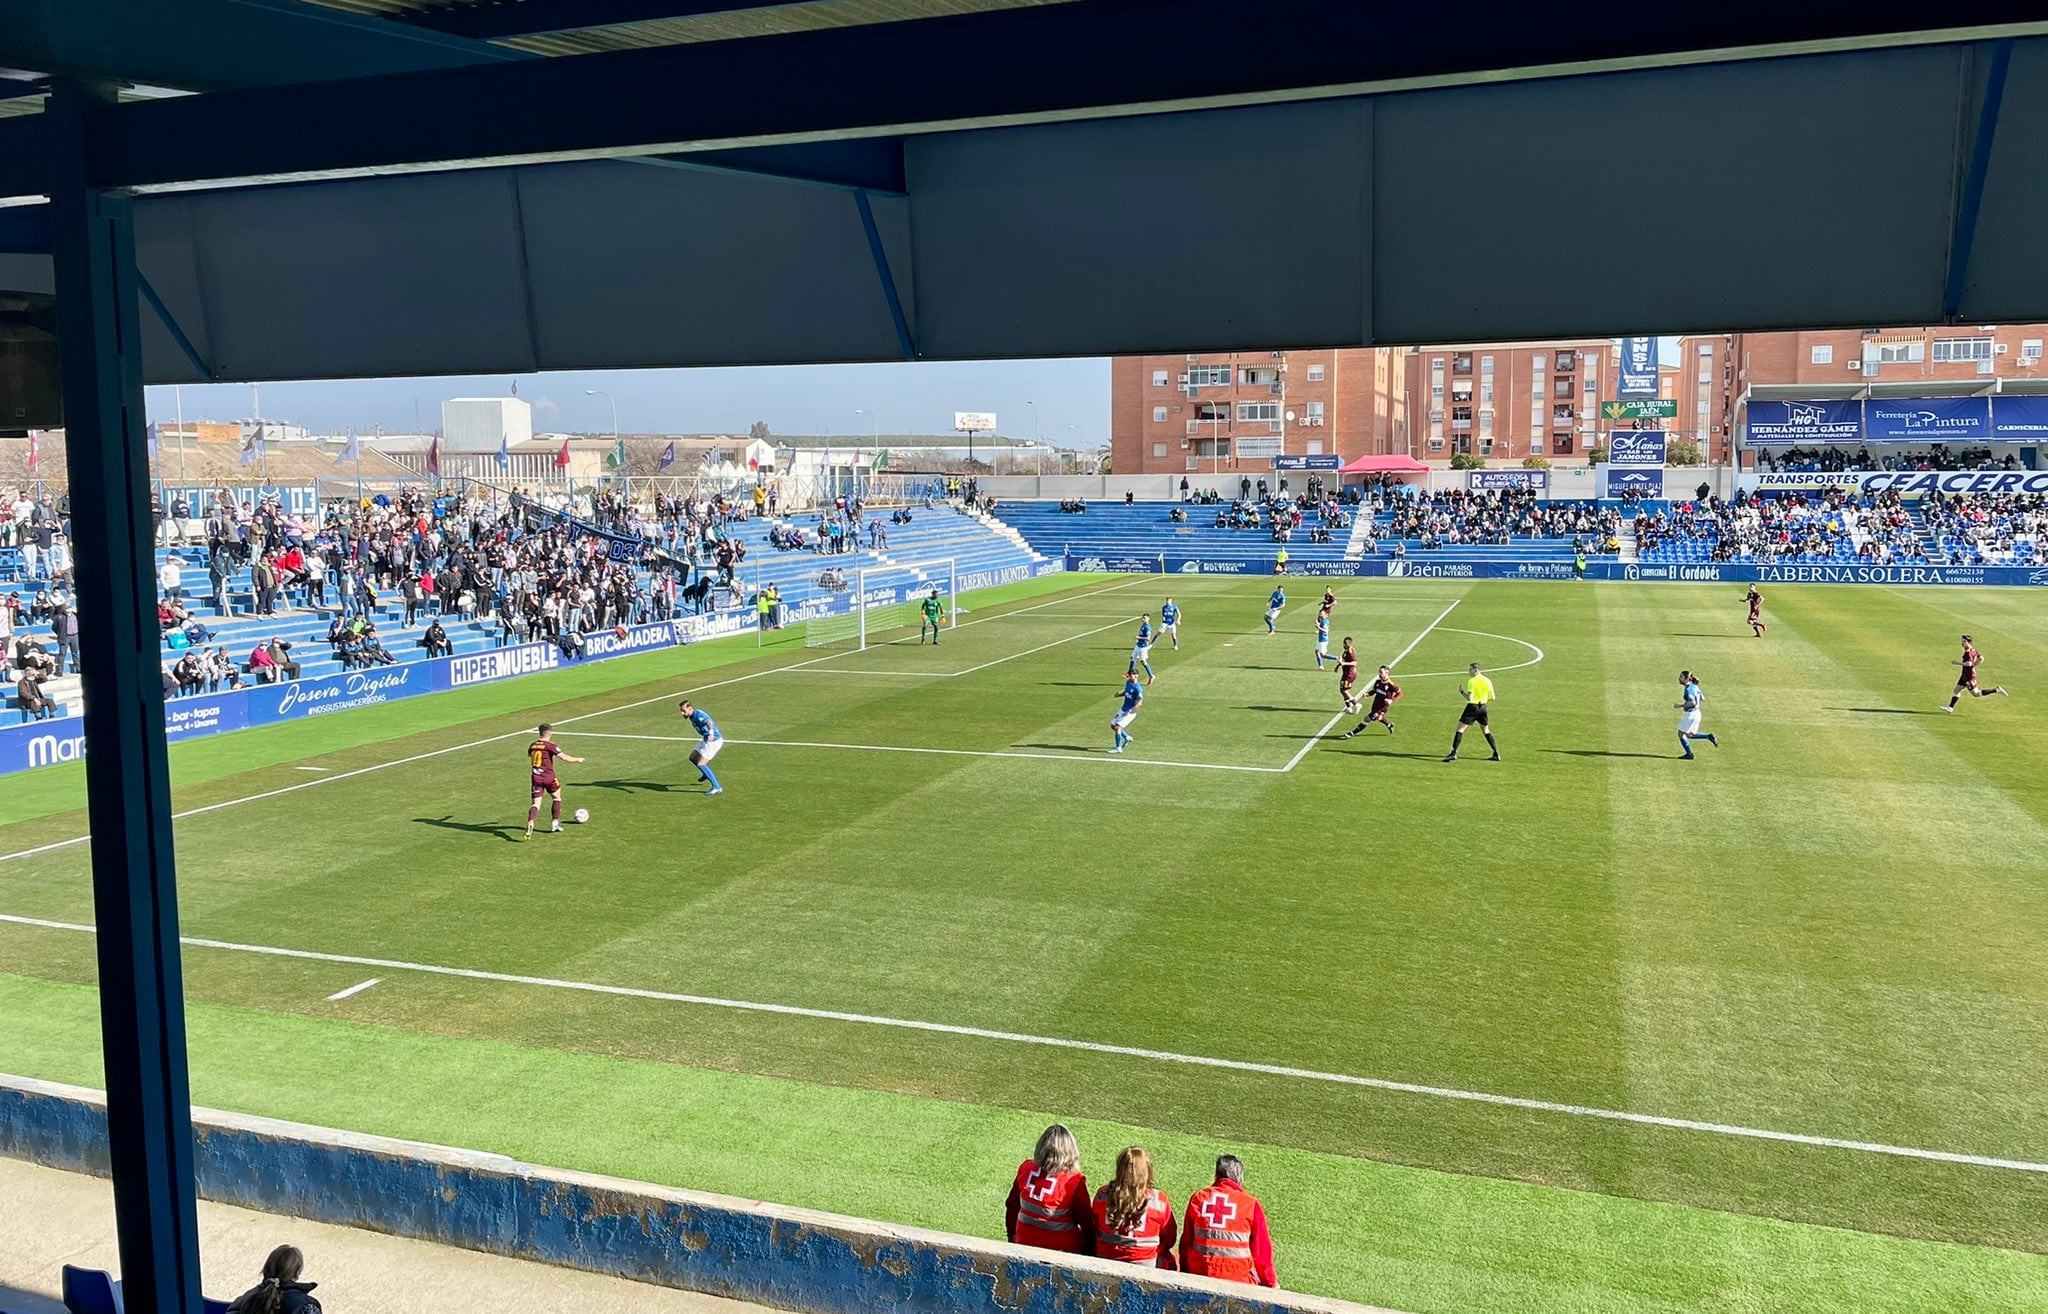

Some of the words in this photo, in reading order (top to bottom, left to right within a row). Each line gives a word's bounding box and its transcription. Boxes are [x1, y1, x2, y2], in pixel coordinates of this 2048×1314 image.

[1646, 400, 1674, 408] RURAL
[1794, 415, 1812, 425] HG
[1876, 410, 1917, 419] Ferretería
[1905, 417, 1921, 428] La
[1917, 411, 1980, 428] Pintura
[1751, 424, 1819, 434] HERNÁNDEZ
[1820, 424, 1859, 433] GÁMEZ
[1471, 473, 1483, 488] R
[1485, 473, 1509, 481] AUTOS
[1758, 474, 1860, 485] TRANSPORTES
[1306, 562, 1361, 570] AYUNTAMIENTO
[1403, 561, 1442, 577] Jaén
[1668, 567, 1677, 580] El
[1679, 565, 1721, 581] Cordobés
[957, 573, 993, 592] TABERNA
[999, 566, 1030, 584] MONTES
[1756, 566, 1854, 582] TABERNA
[1857, 567, 1943, 584] SOLERA
[780, 600, 817, 625] Basilio
[278, 683, 342, 715] Joseva
[346, 668, 409, 697] Digital
[194, 718, 218, 729] Linares
[28, 735, 87, 768] Mar
